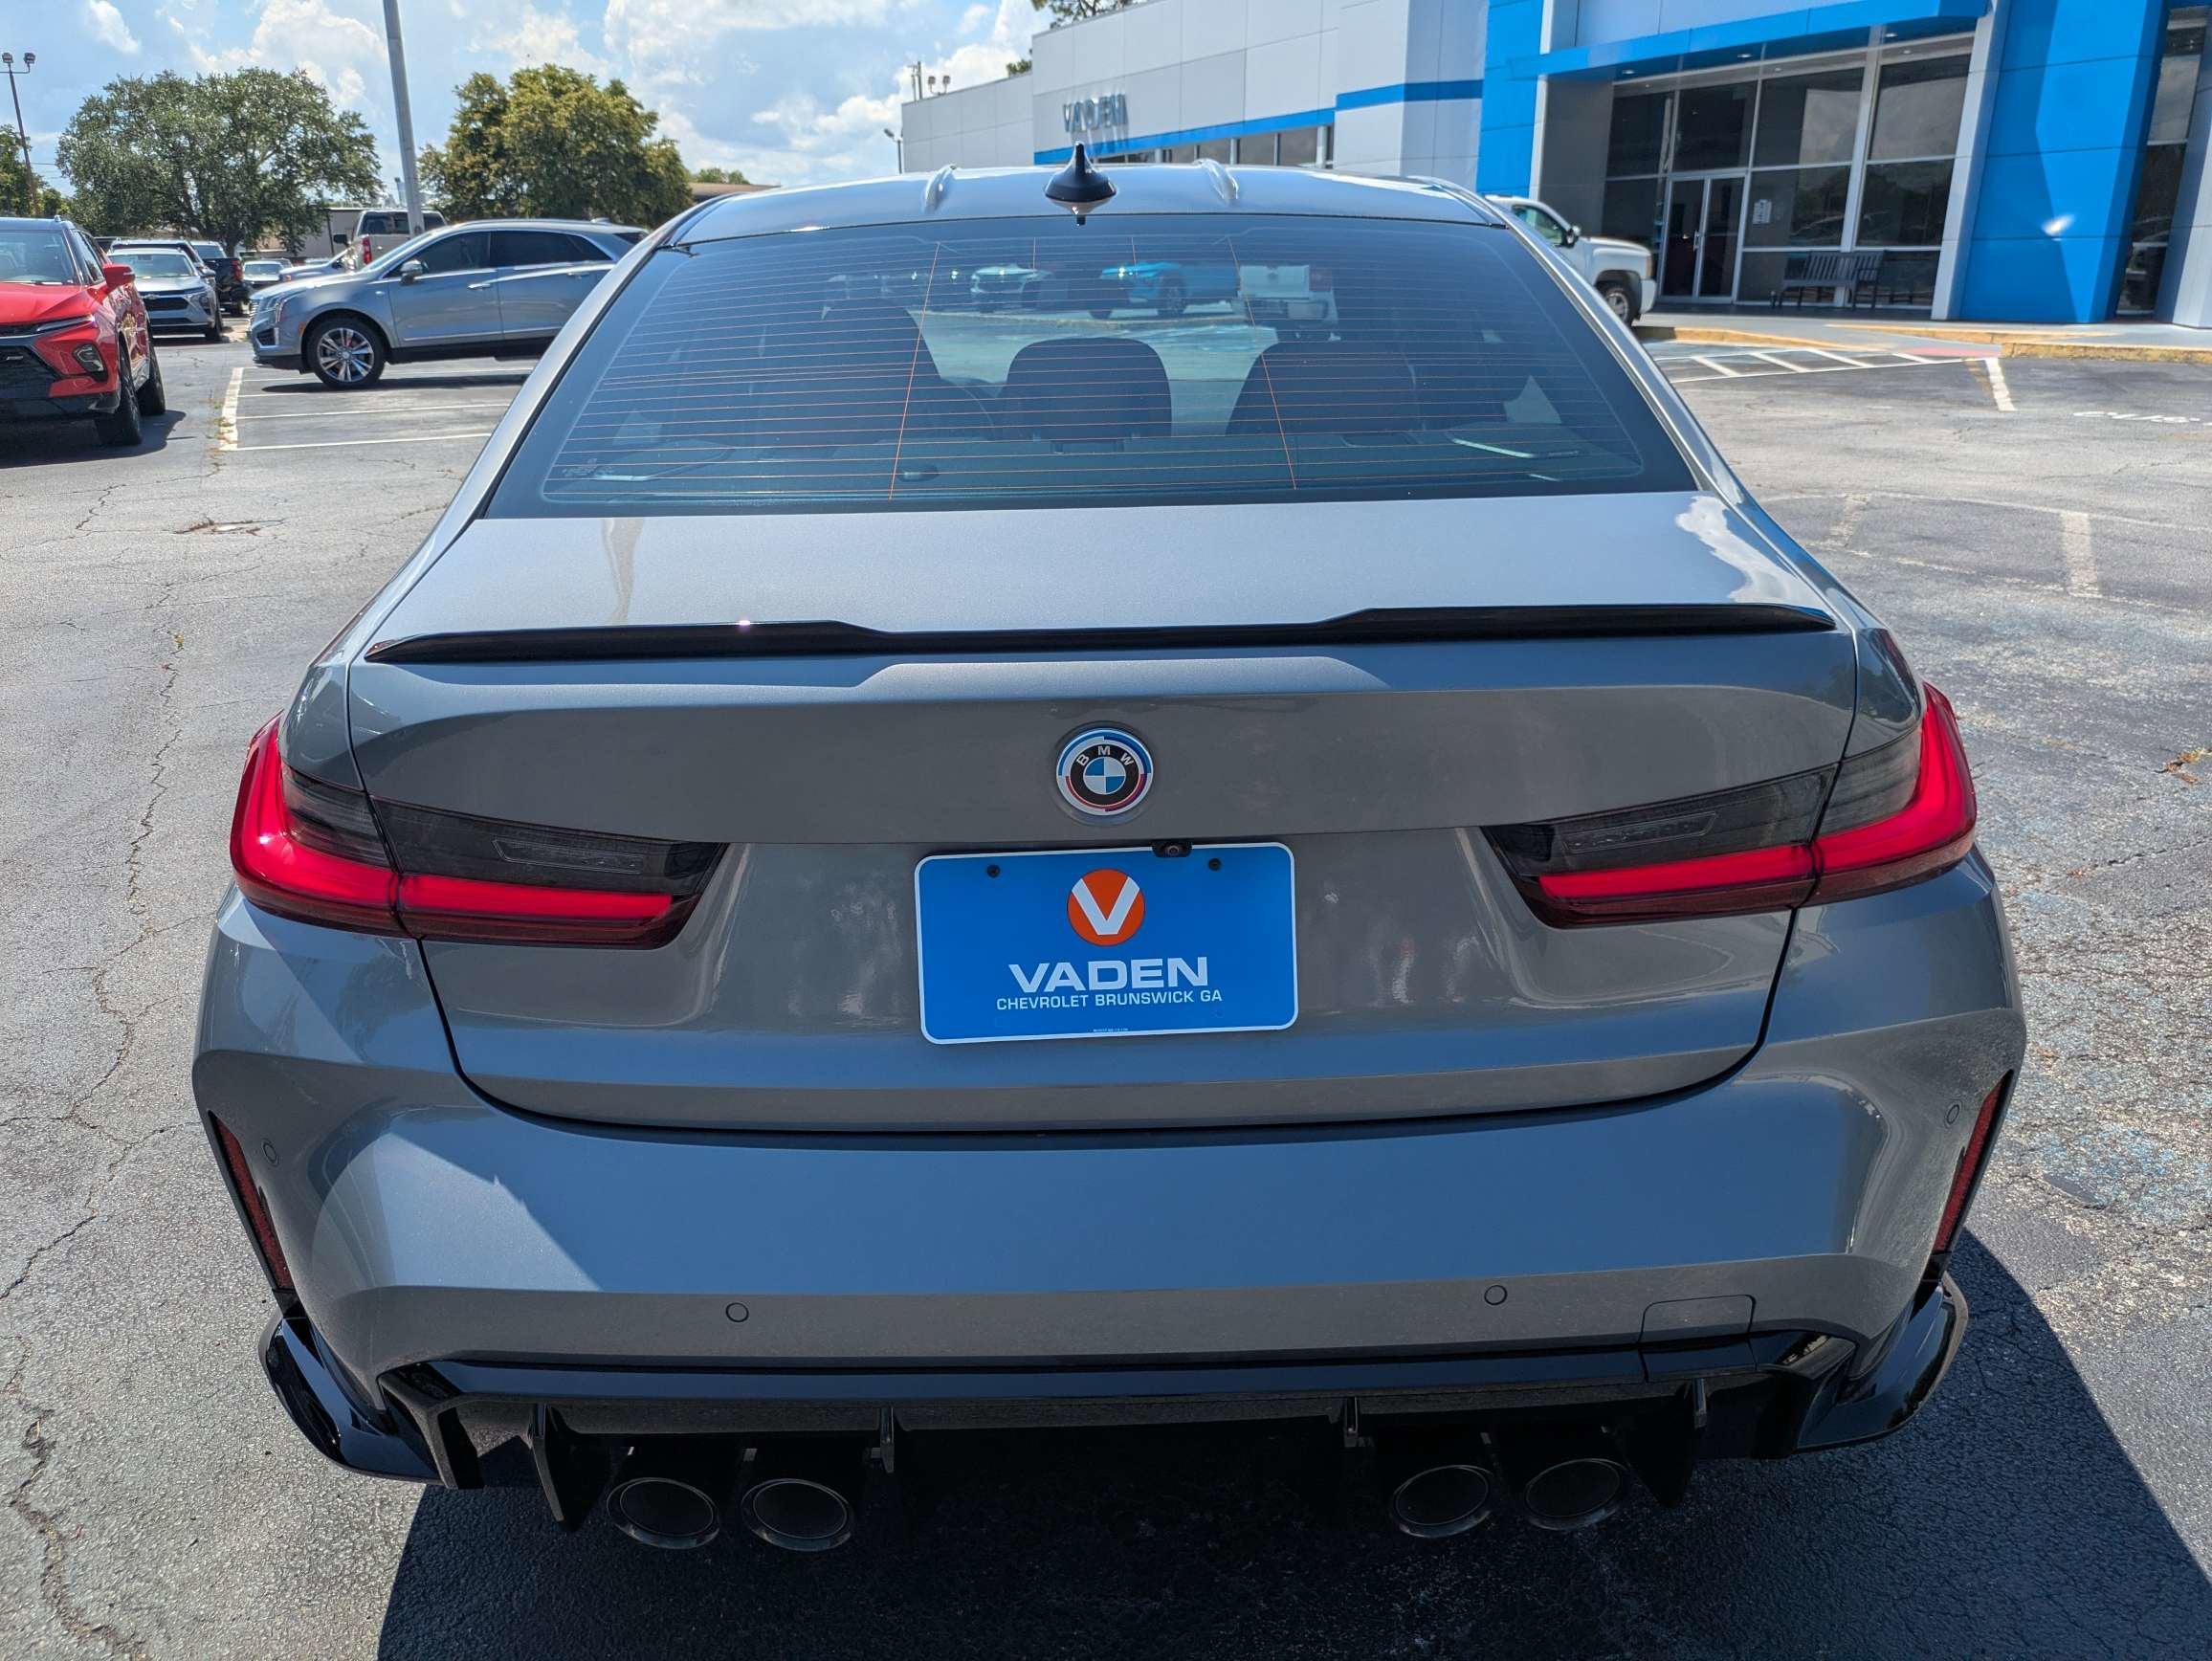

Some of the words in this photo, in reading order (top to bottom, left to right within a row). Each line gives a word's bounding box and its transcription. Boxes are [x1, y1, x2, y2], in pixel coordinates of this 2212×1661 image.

[1076, 745, 1134, 766] BMW
[1008, 957, 1209, 993] VADEN
[996, 994, 1089, 1010] CHEVROLET
[1095, 991, 1194, 1007] BRUNSWICK
[1200, 989, 1223, 1003] GA
